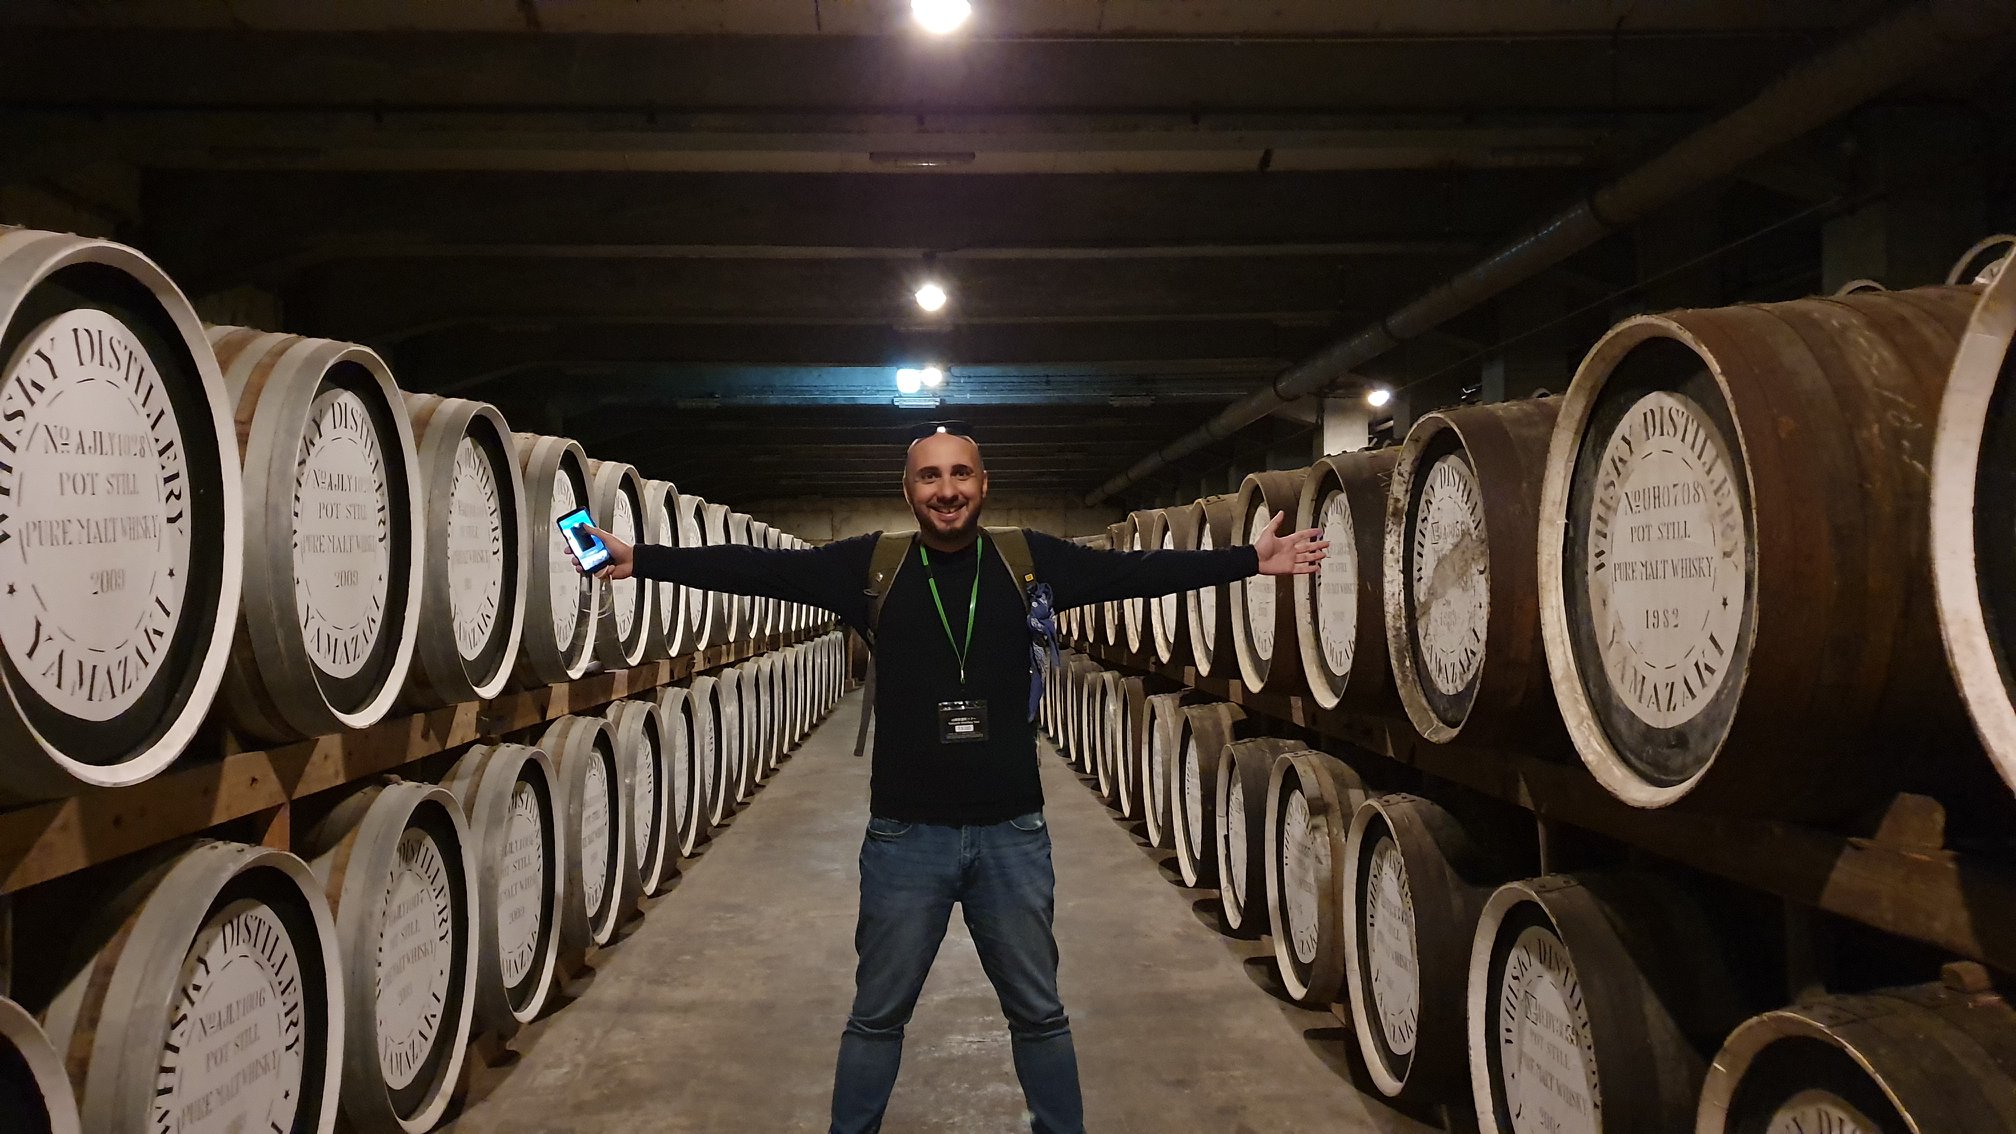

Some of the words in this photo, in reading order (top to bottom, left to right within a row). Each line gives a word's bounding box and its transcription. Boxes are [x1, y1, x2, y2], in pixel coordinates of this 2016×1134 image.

[71, 327, 185, 537] DISTILLERY
[58, 471, 99, 497] POT
[105, 472, 140, 497] STILL
[331, 400, 388, 552] DISTILLERY
[1594, 424, 1634, 574] WHISKY
[1641, 405, 1738, 572] DISTILLERY
[26, 519, 73, 548] PURE
[76, 516, 119, 545] MALT
[119, 514, 158, 542] WHISKY
[317, 501, 341, 521] POT
[345, 503, 367, 521] STILL
[1438, 464, 1488, 586] DISTILLEY
[1629, 524, 1654, 543] POT
[1656, 520, 1691, 541] STILL
[90, 568, 126, 595] 2009
[334, 569, 359, 588] 2009
[1613, 561, 1638, 583] PURE
[1639, 559, 1669, 581] MALT
[1670, 555, 1713, 580] WHISKY
[303, 595, 381, 665] YAMAZAKI
[1645, 608, 1680, 630] 1982
[25, 596, 172, 702] YAMAZAKI
[1607, 622, 1724, 713] YAMAZAKI
[221, 913, 300, 1058] DISTILLERY
